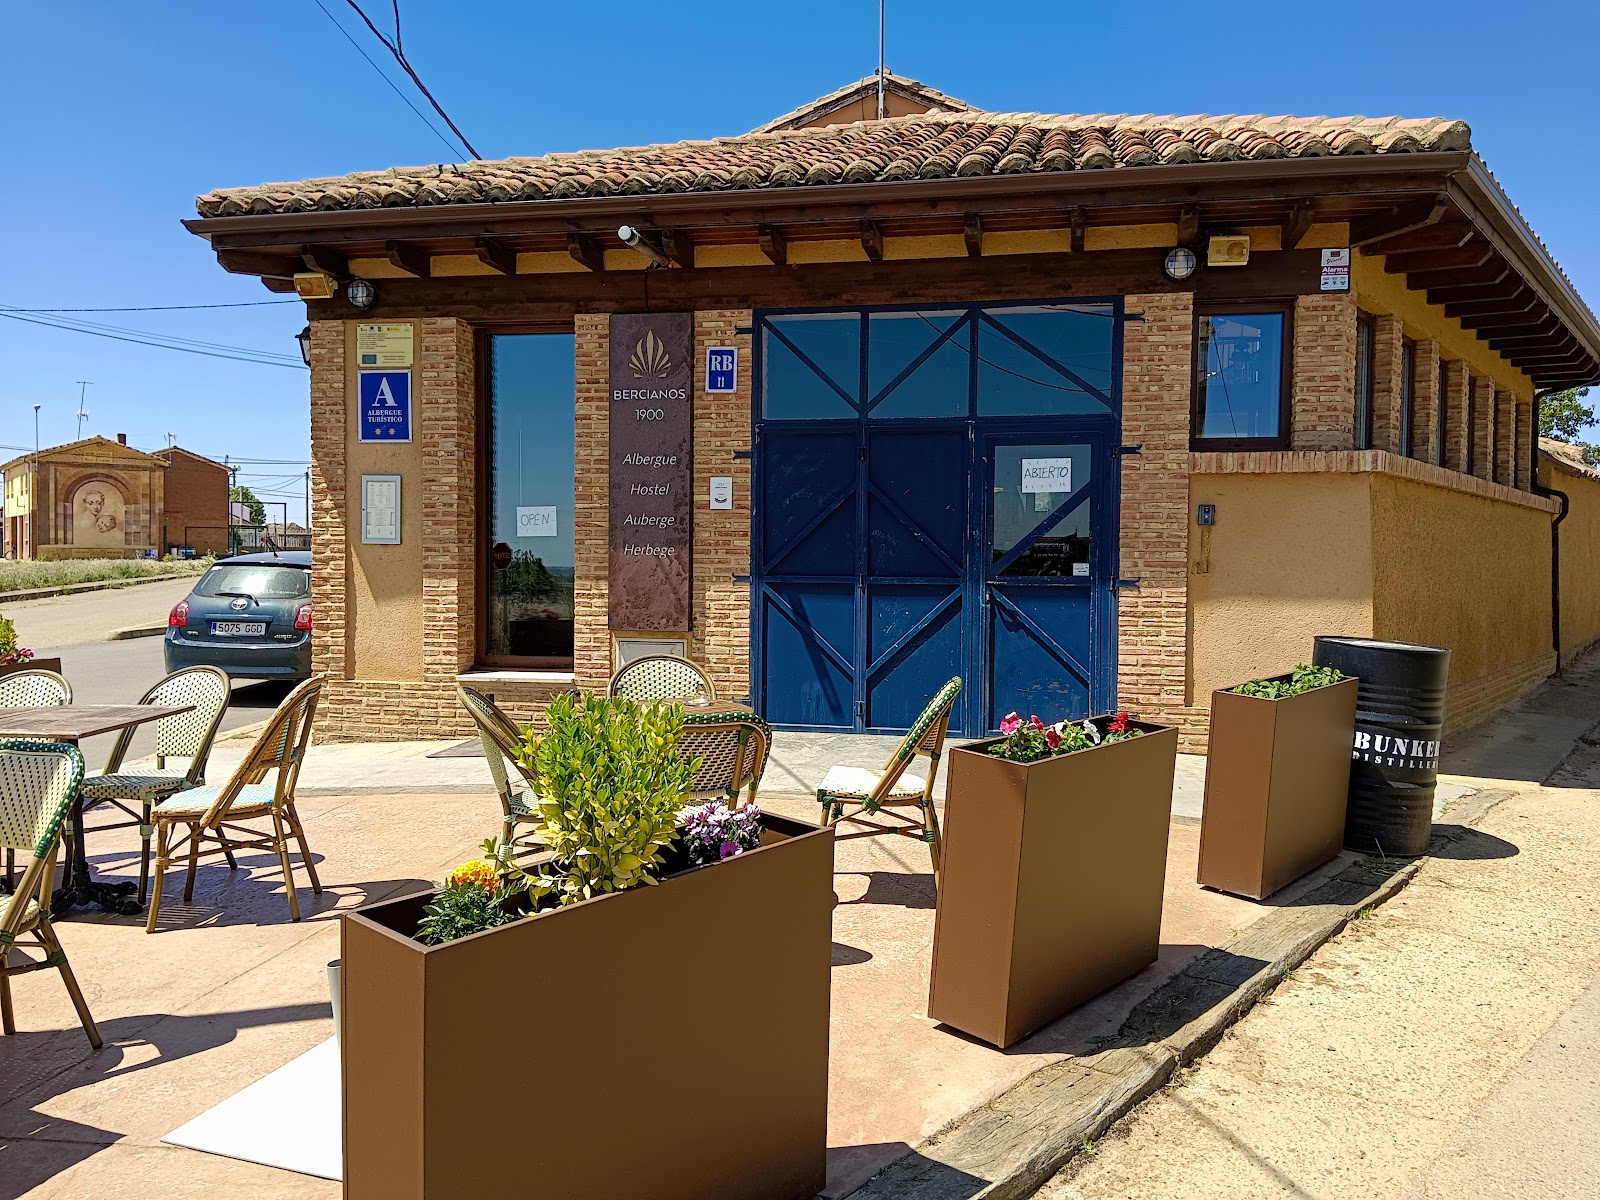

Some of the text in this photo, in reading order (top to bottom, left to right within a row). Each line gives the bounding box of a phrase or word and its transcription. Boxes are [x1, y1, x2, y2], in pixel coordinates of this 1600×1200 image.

[710, 354, 733, 371] RB
[371, 376, 398, 407] A
[613, 388, 686, 401] BERCIANOS
[367, 415, 403, 423] TURÍSTICO
[634, 408, 664, 421] 1900
[622, 452, 677, 469] Albergue
[1023, 465, 1069, 479] ABIERTO
[630, 483, 670, 496] Hostel
[520, 512, 550, 527] OPEN
[623, 513, 675, 529] Auberge
[623, 543, 675, 559] Herbege
[218, 622, 263, 634] 5075 GGD
